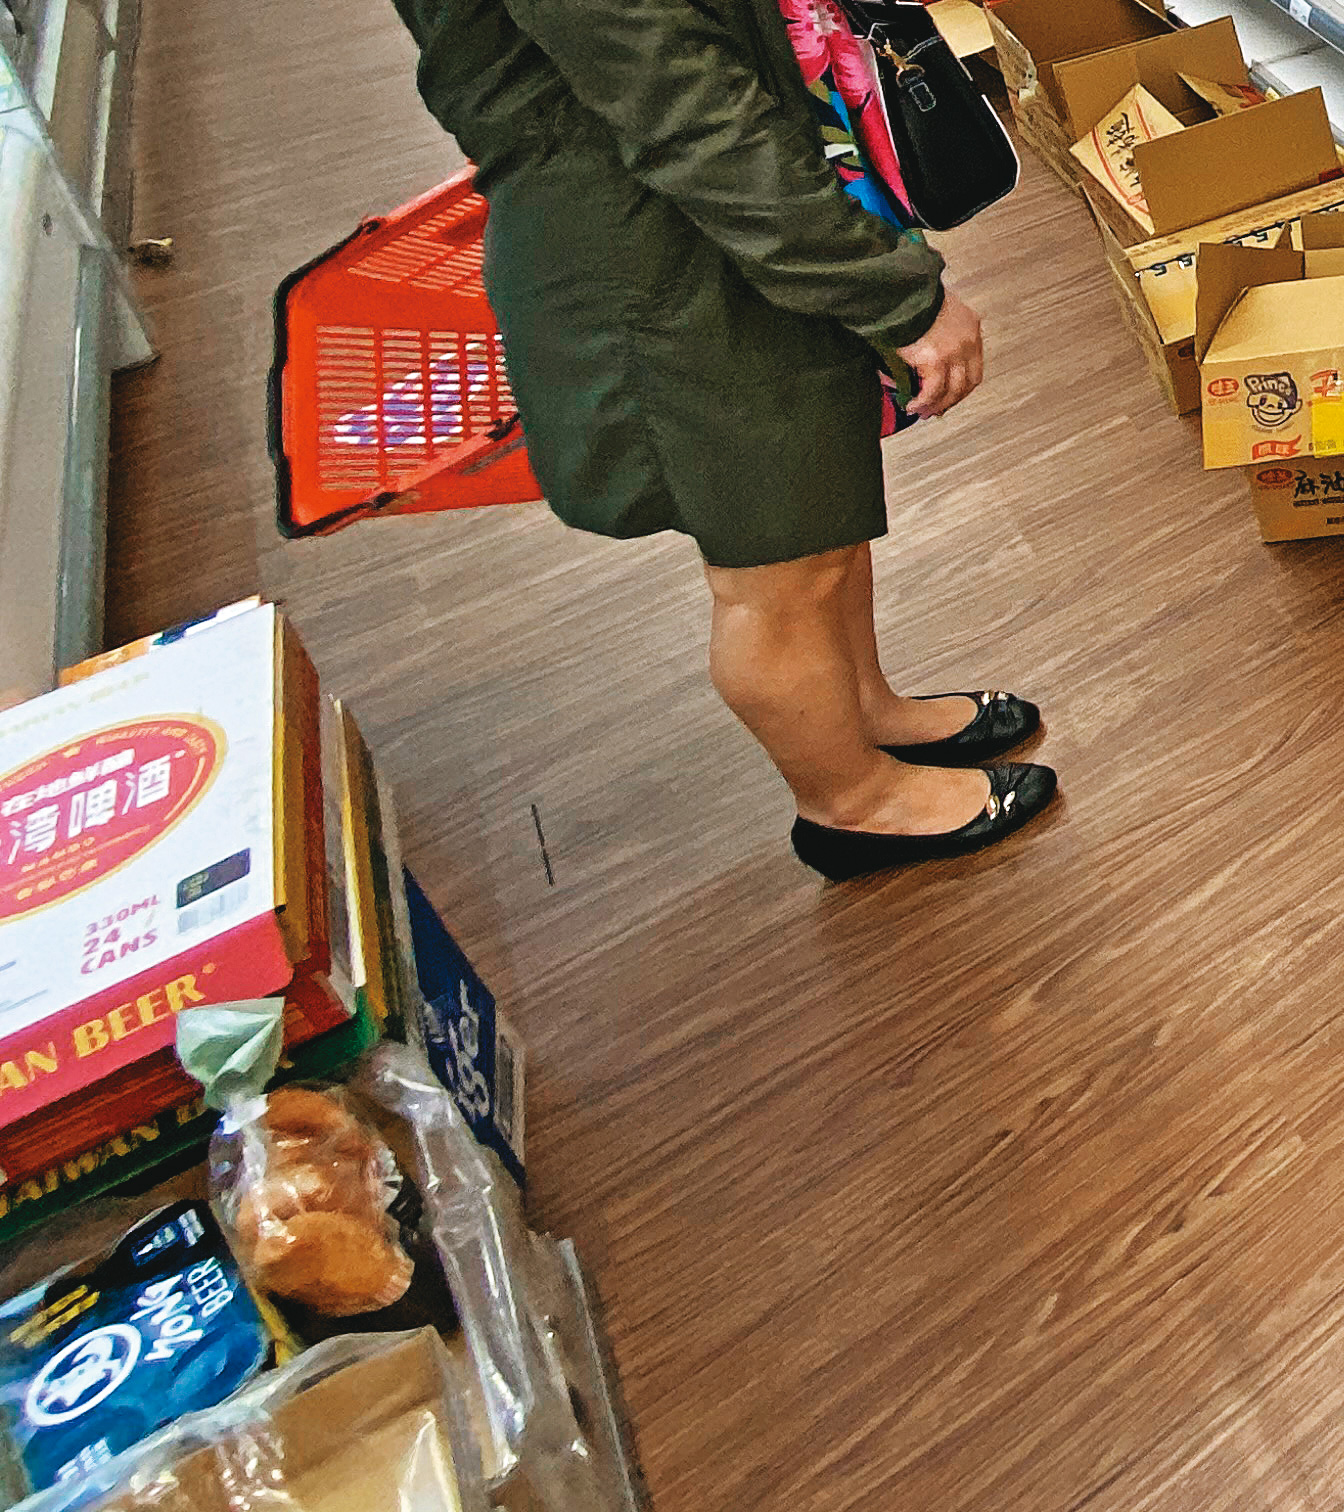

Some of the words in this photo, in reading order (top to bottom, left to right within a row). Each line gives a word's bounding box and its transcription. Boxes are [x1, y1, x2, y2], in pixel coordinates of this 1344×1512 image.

[84, 894, 161, 936] 330ML
[80, 928, 160, 975] CANS
[82, 927, 121, 956] 24
[72, 974, 206, 1058] BEER
[186, 1254, 235, 1319] BEER
